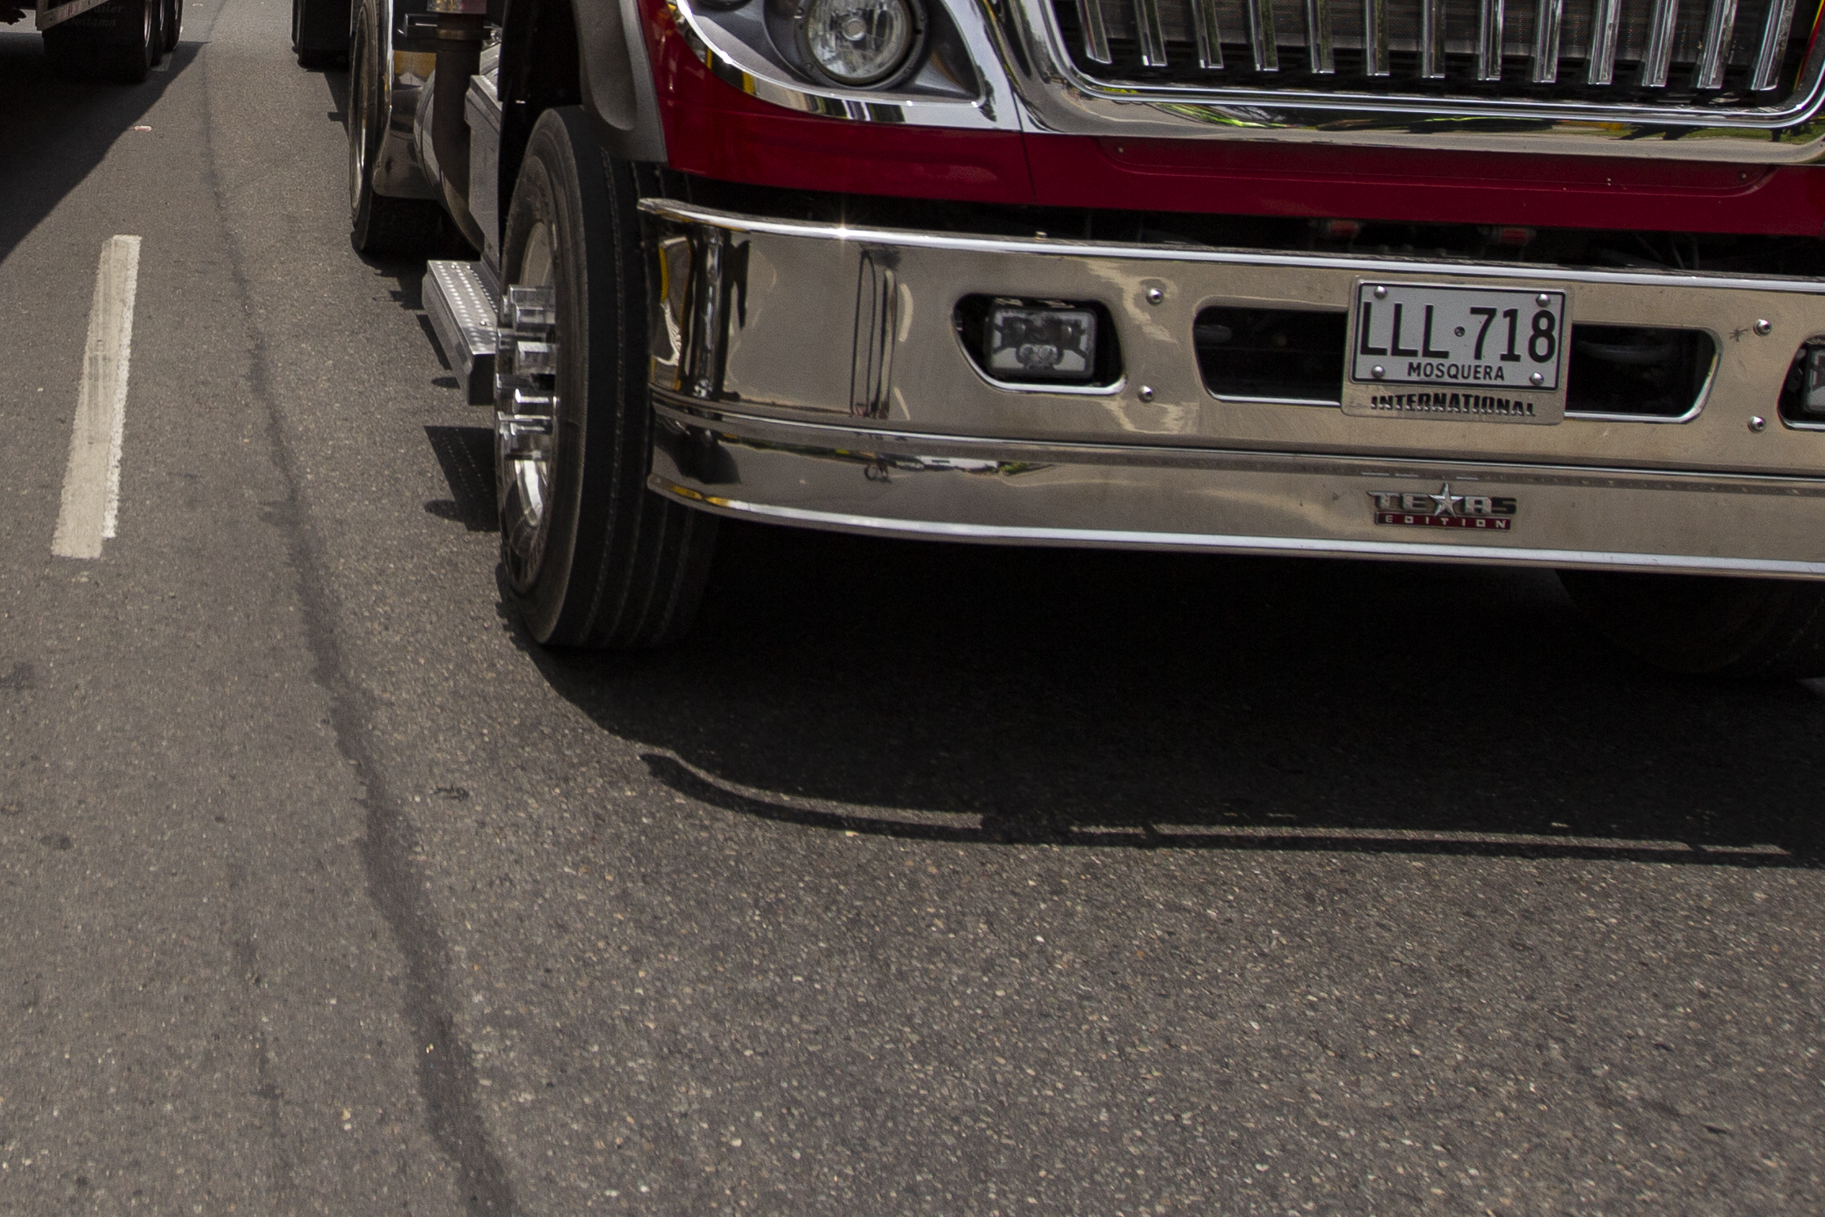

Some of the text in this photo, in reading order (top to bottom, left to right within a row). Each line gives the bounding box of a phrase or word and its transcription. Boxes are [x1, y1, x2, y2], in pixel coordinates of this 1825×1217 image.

[1407, 362, 1505, 381] MOSQUERA
[1371, 392, 1536, 418] INTERNATIONAL
[1385, 515, 1507, 529] EDITION
